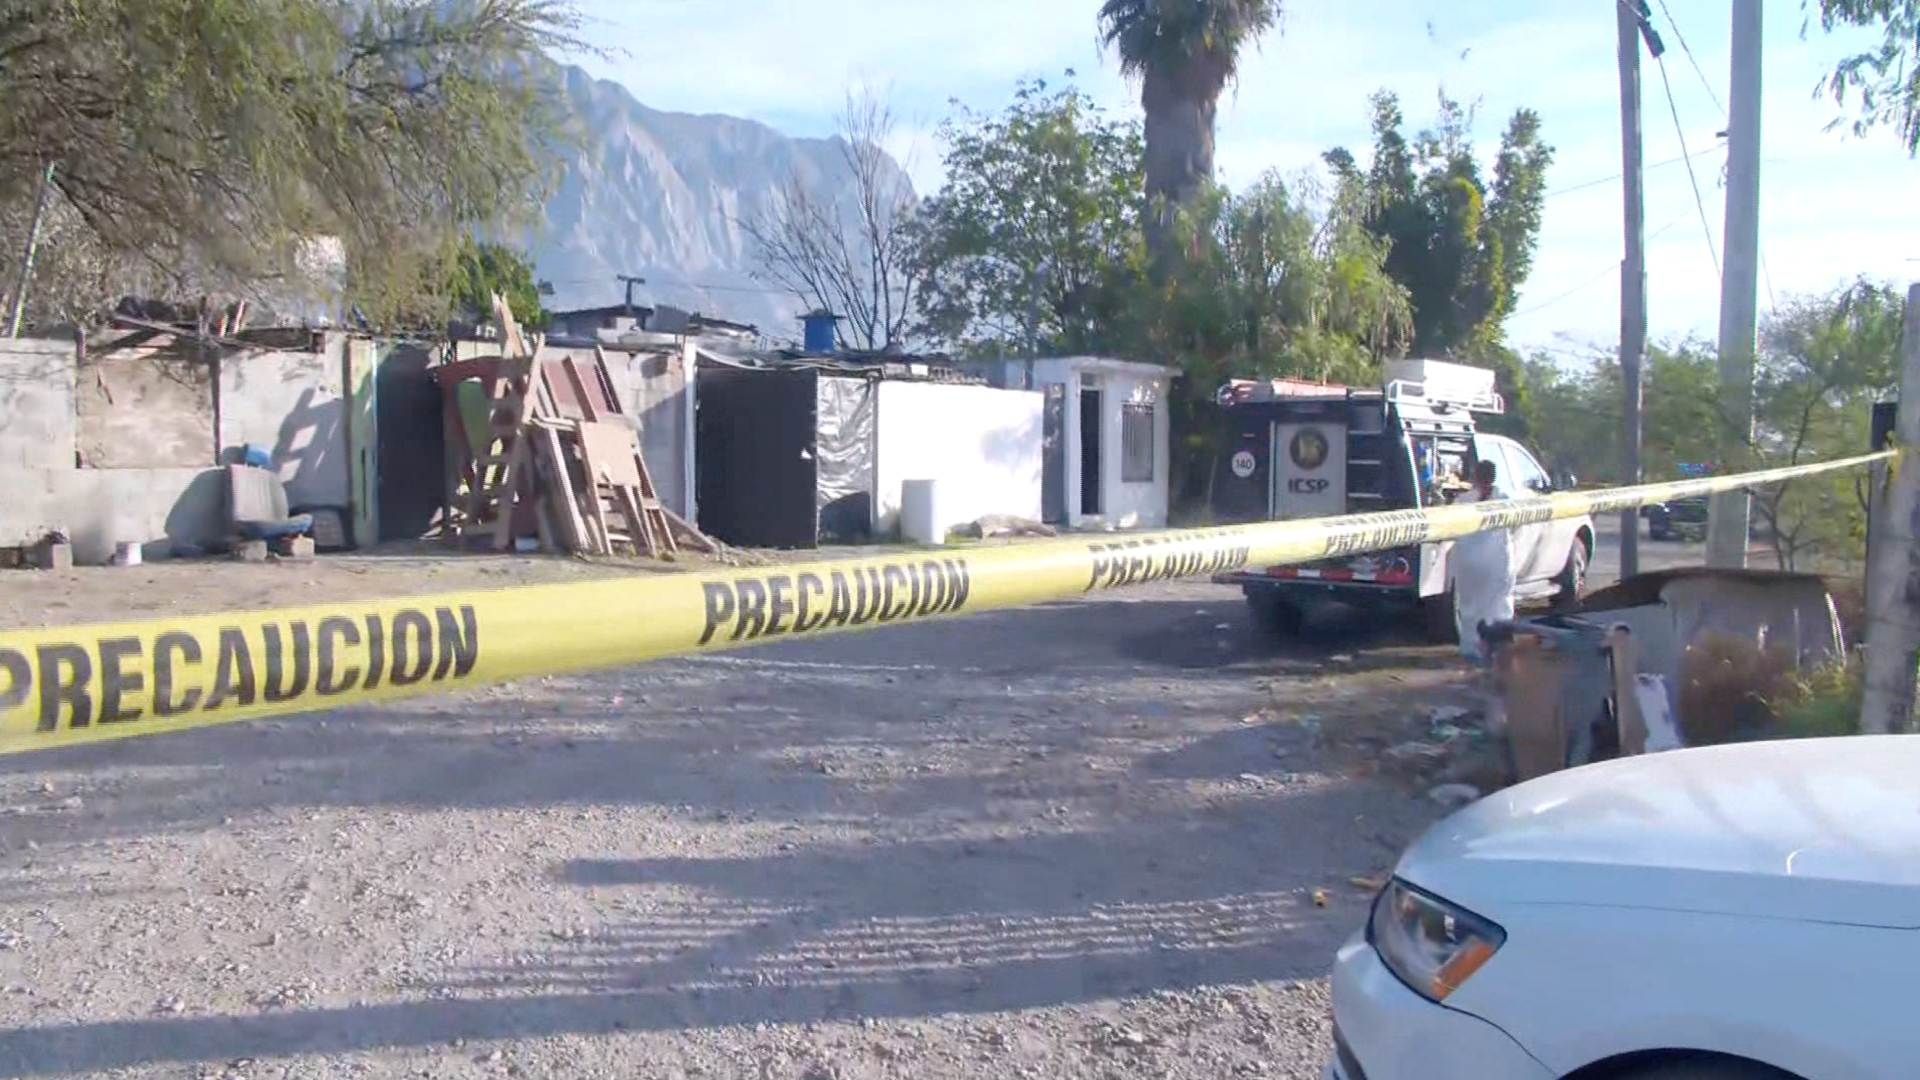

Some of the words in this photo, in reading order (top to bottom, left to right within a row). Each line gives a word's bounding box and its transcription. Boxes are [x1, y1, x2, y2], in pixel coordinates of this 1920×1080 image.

[1287, 478, 1329, 493] ICSP
[698, 558, 970, 645] PRECAUCION
[0, 604, 477, 733] PRECAUCION
